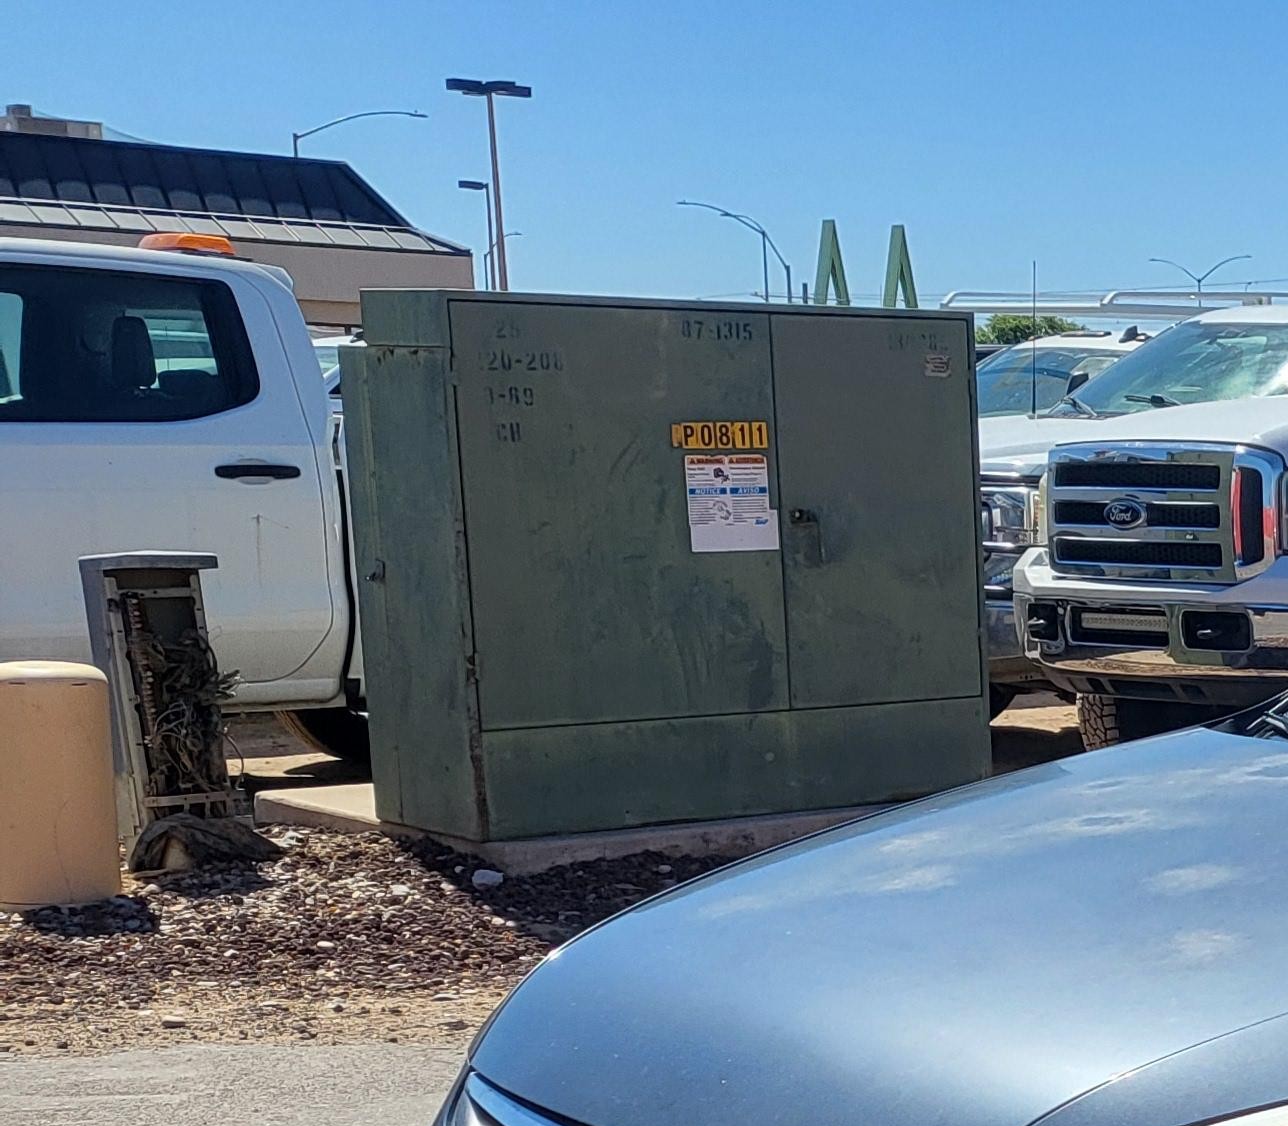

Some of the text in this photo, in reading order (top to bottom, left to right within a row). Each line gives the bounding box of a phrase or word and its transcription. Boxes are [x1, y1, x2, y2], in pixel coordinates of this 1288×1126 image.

[682, 424, 765, 448] P0811
[694, 487, 721, 495] NOTICE
[737, 486, 760, 494] AVISO
[1110, 504, 1132, 521] Ford
